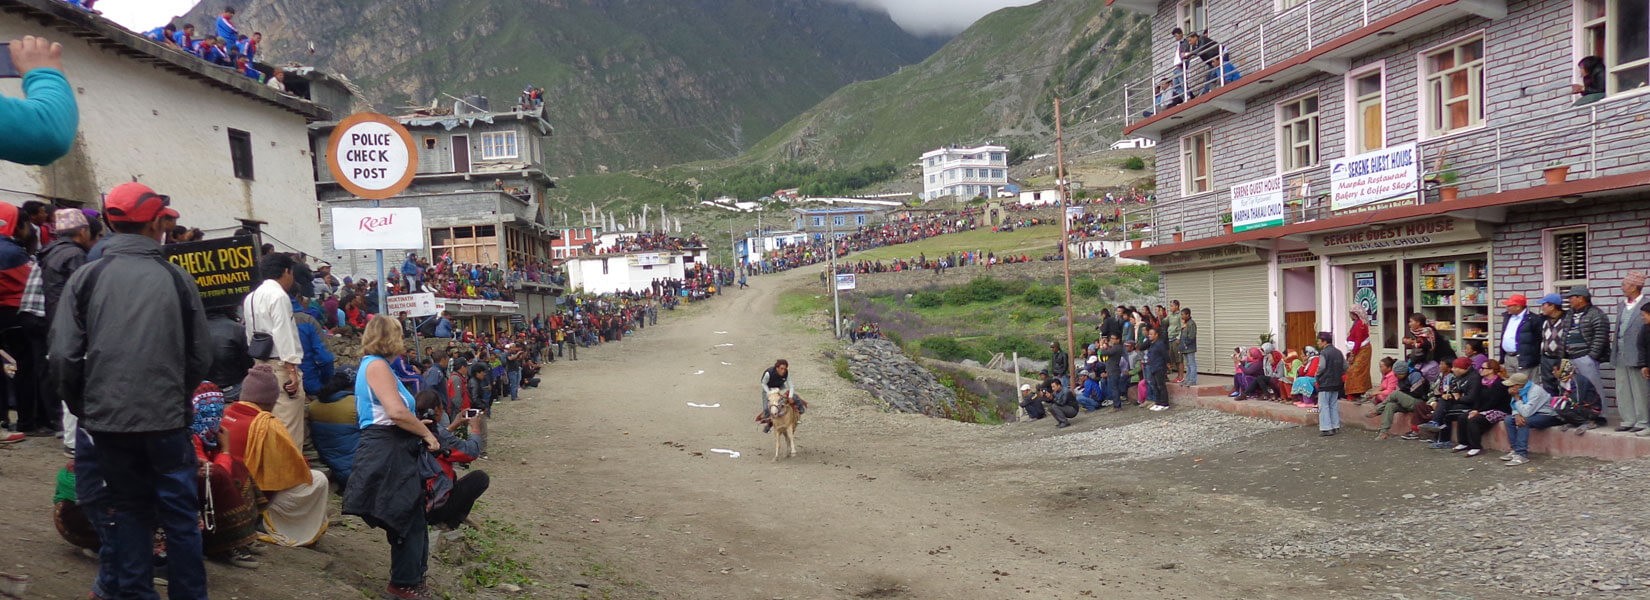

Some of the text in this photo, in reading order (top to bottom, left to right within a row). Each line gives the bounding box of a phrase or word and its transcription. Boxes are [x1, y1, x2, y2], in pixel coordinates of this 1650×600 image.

[352, 133, 391, 146] POLICE
[346, 149, 389, 162] CHECK
[1348, 148, 1412, 178] SERENE GUEST HOUSE
[353, 167, 388, 179] POST
[1338, 170, 1407, 190] Marpha Restaurant
[1234, 178, 1280, 199] SERENE GUEST HOUSE
[1335, 190, 1358, 201] Bakery
[1367, 185, 1390, 196] Coffee
[1392, 181, 1412, 191] Shop
[1250, 206, 1267, 219] THAKALI
[1268, 203, 1281, 216] CHULO
[359, 213, 393, 232] Real
[1323, 220, 1454, 247] SERENE GUEST HOUSE
[1347, 236, 1431, 251] THAKALI CHULO
[217, 246, 254, 270] POST
[195, 272, 250, 287] MUKTINATH
